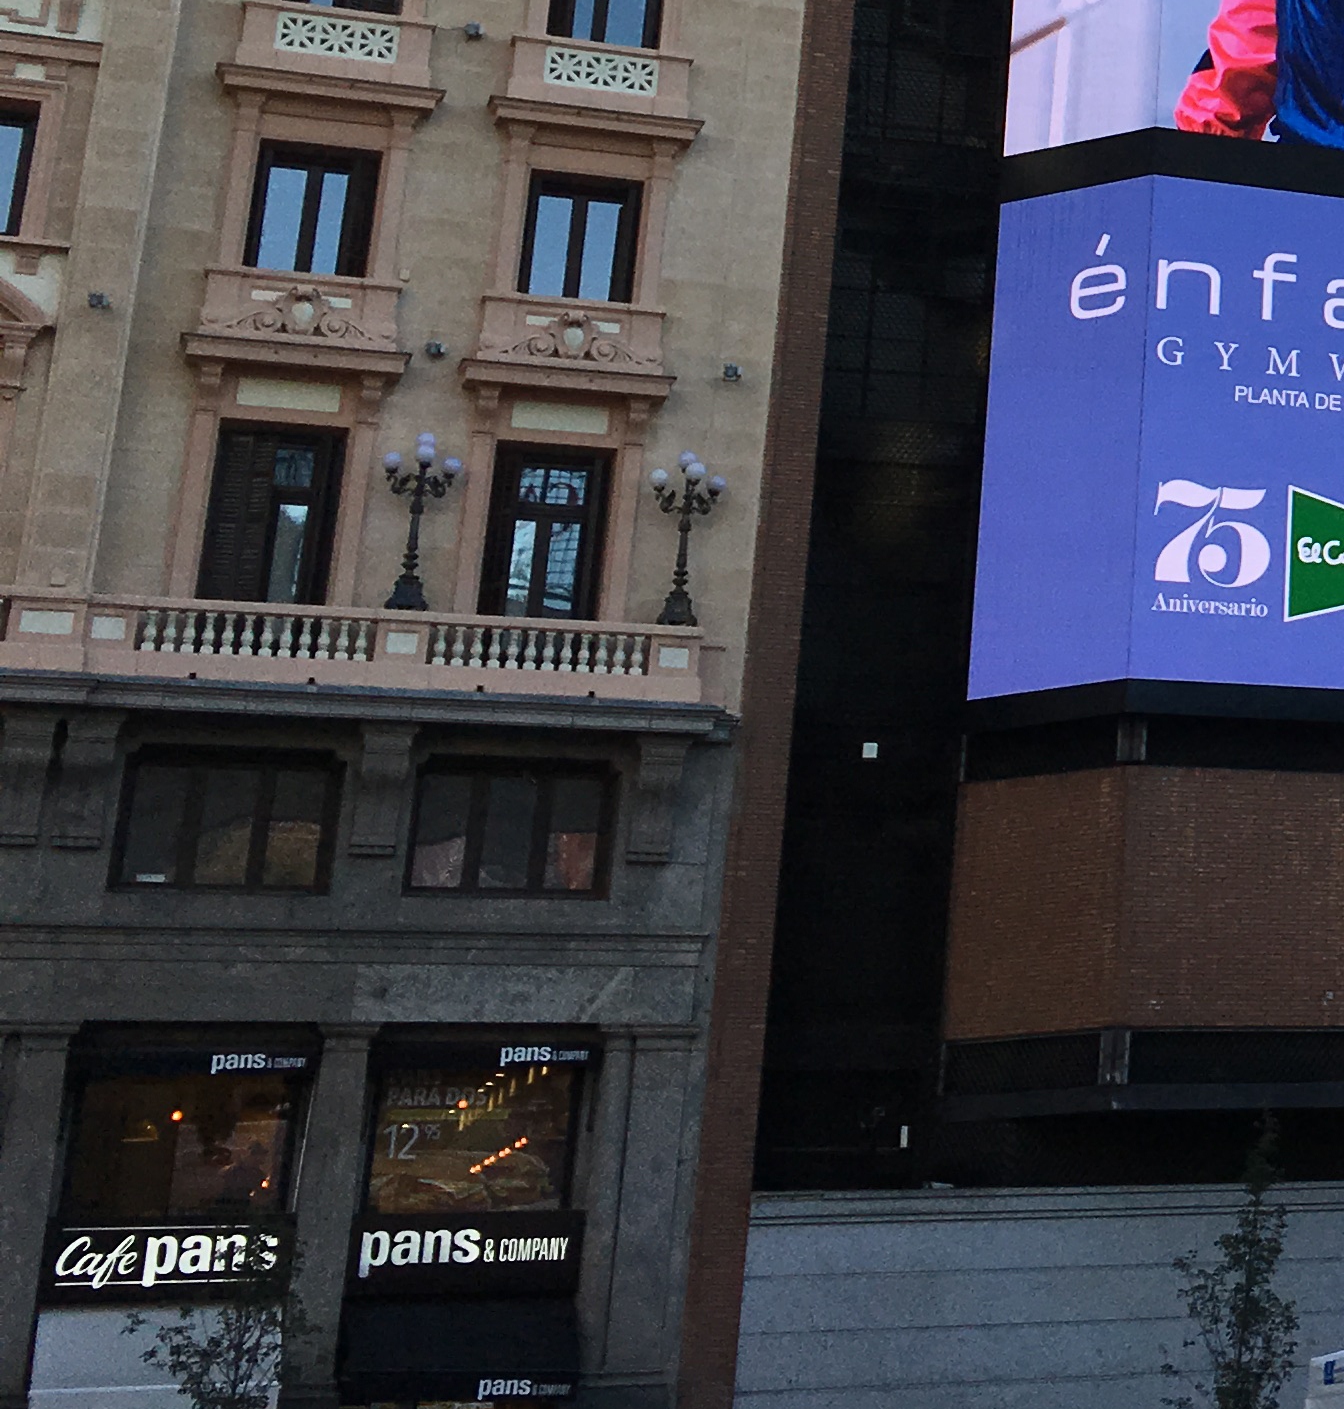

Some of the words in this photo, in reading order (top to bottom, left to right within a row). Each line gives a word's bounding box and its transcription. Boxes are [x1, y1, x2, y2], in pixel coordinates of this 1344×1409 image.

[1233, 385, 1310, 409] PLANTA
[1314, 392, 1342, 412] DE
[1153, 479, 1272, 589] 75
[1297, 536, 1324, 564] El
[1150, 592, 1269, 618] Aniversario
[210, 1053, 266, 1075] pans
[499, 1045, 552, 1067] pans
[55, 1235, 139, 1290] Cafe
[357, 1228, 482, 1278] pans
[483, 1238, 495, 1263] &
[499, 1237, 570, 1263] COMPANY
[477, 1377, 532, 1401] pans
